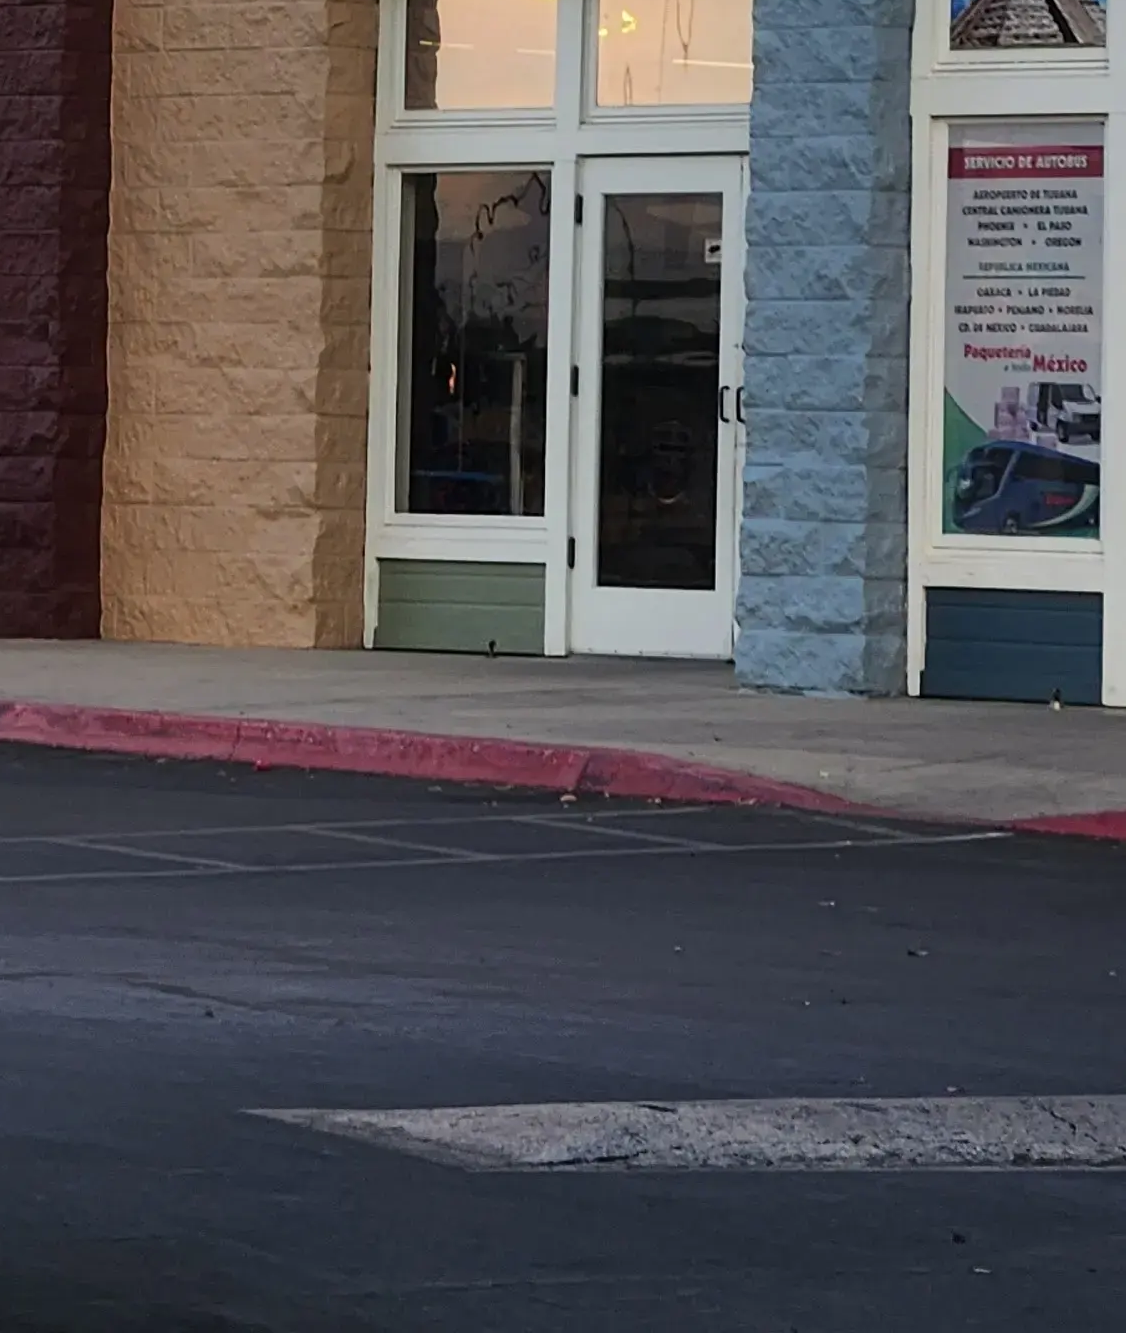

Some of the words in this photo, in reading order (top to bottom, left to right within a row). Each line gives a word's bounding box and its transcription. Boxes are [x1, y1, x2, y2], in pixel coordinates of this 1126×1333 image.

[964, 155, 1015, 170] SERVICIO
[1018, 155, 1033, 169] DE
[962, 205, 998, 216] CENTRAL
[1037, 221, 1047, 231] EL
[1049, 221, 1072, 231] PASO
[1028, 287, 1039, 297] LA
